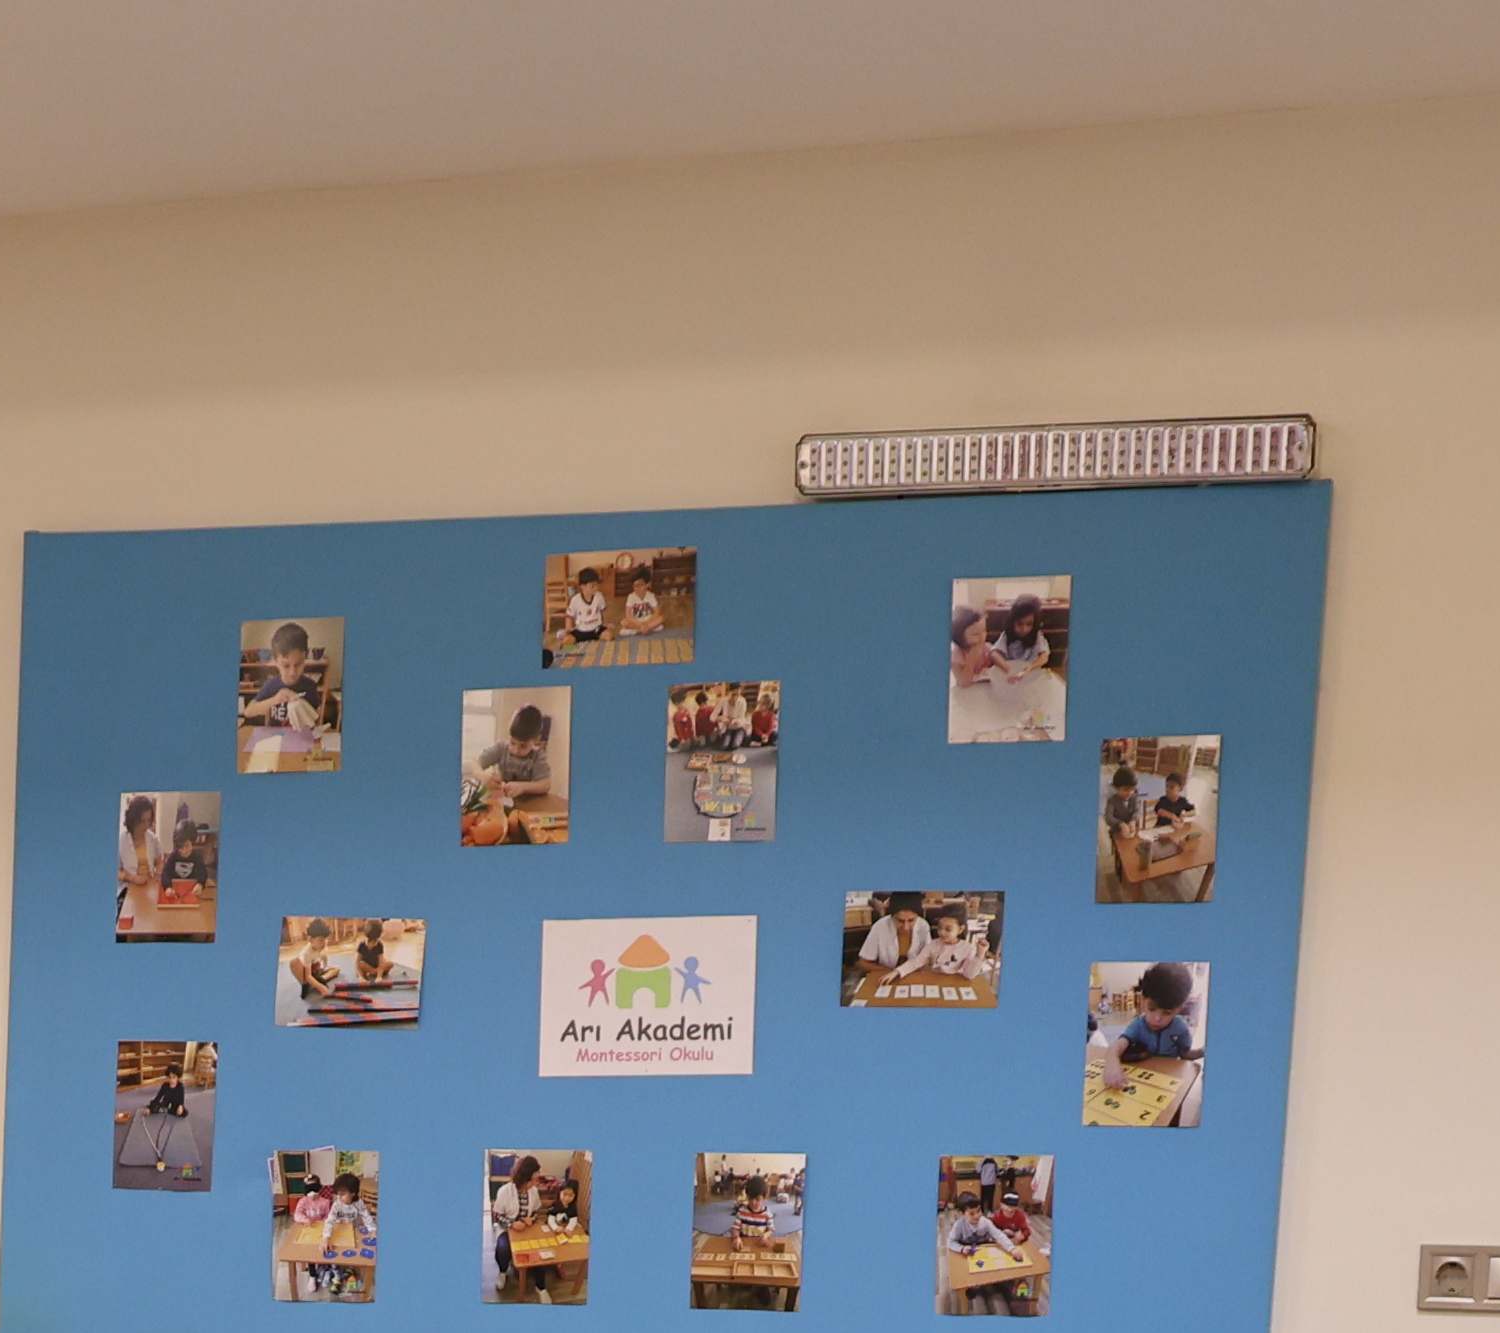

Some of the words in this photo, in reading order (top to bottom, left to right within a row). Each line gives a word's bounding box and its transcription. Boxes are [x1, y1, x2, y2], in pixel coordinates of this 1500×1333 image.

[559, 1018, 602, 1043] Arı
[615, 1016, 734, 1043] Akademi
[575, 1047, 663, 1063] Montessori
[669, 1046, 715, 1062] Okulu
